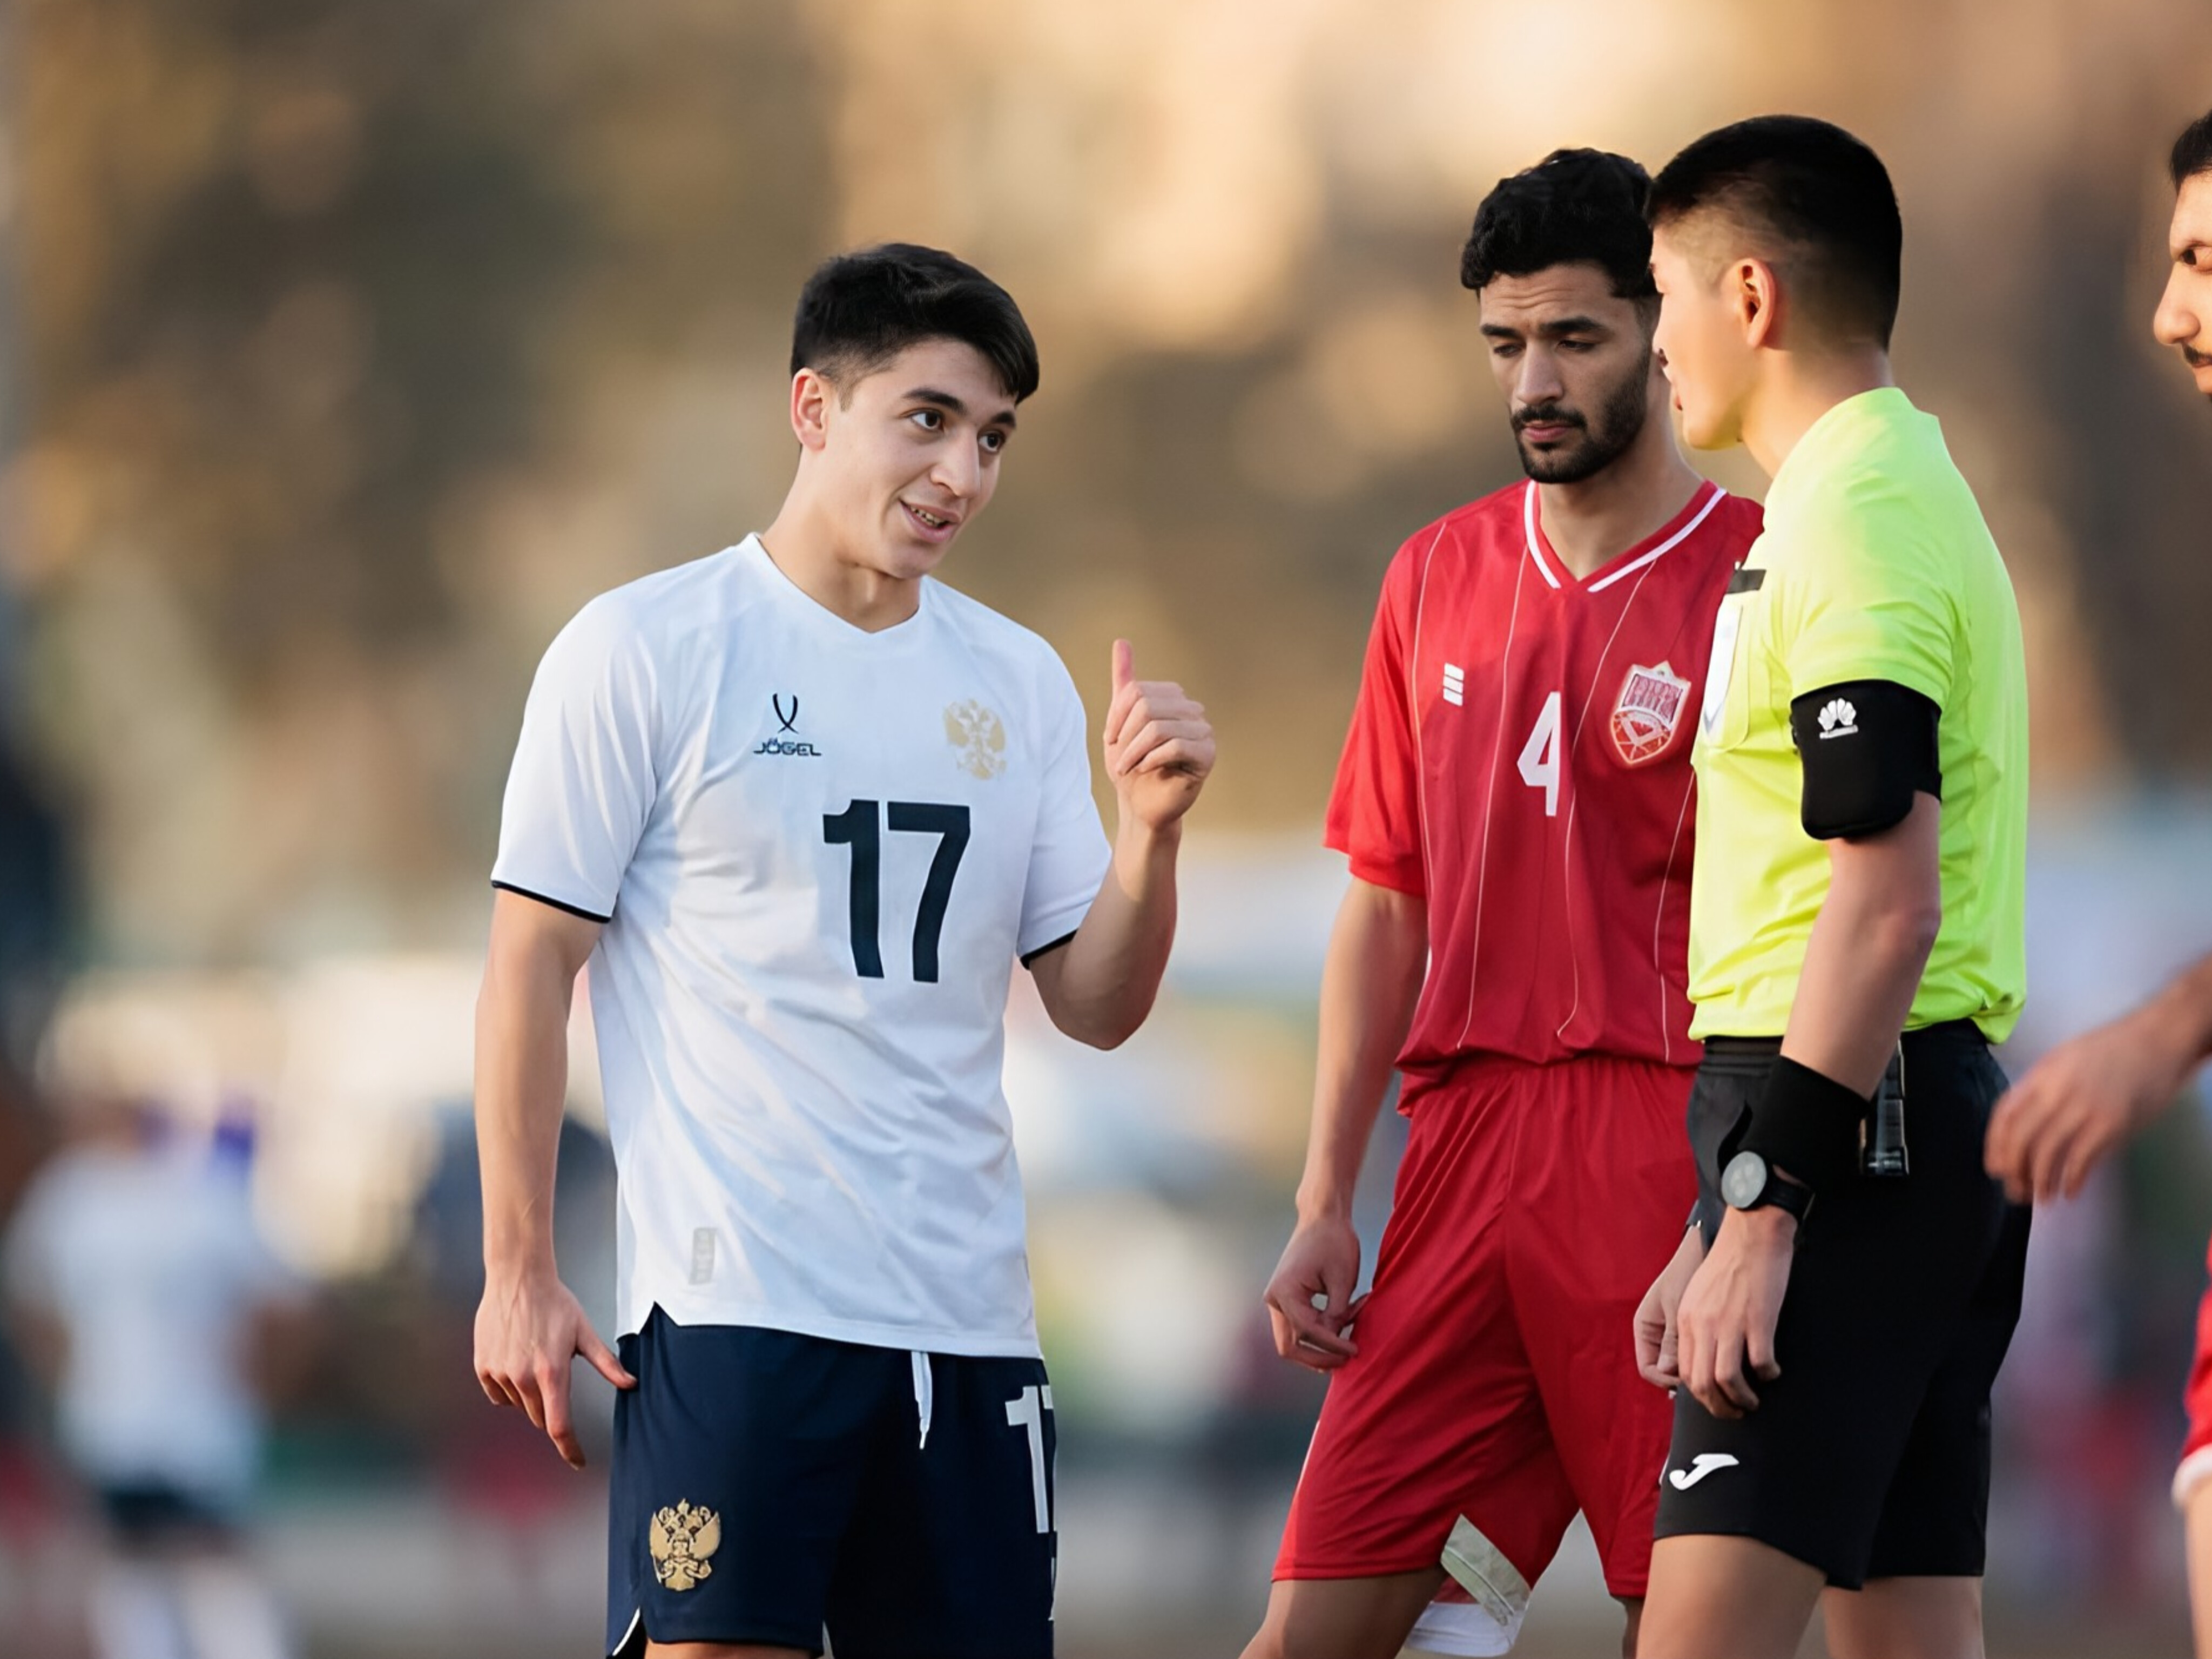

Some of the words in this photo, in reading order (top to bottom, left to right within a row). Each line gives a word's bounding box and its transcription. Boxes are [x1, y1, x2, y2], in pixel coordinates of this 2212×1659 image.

[753, 738, 822, 756] JÖGEL
[1516, 691, 1561, 817] 4
[823, 799, 970, 983] 17
